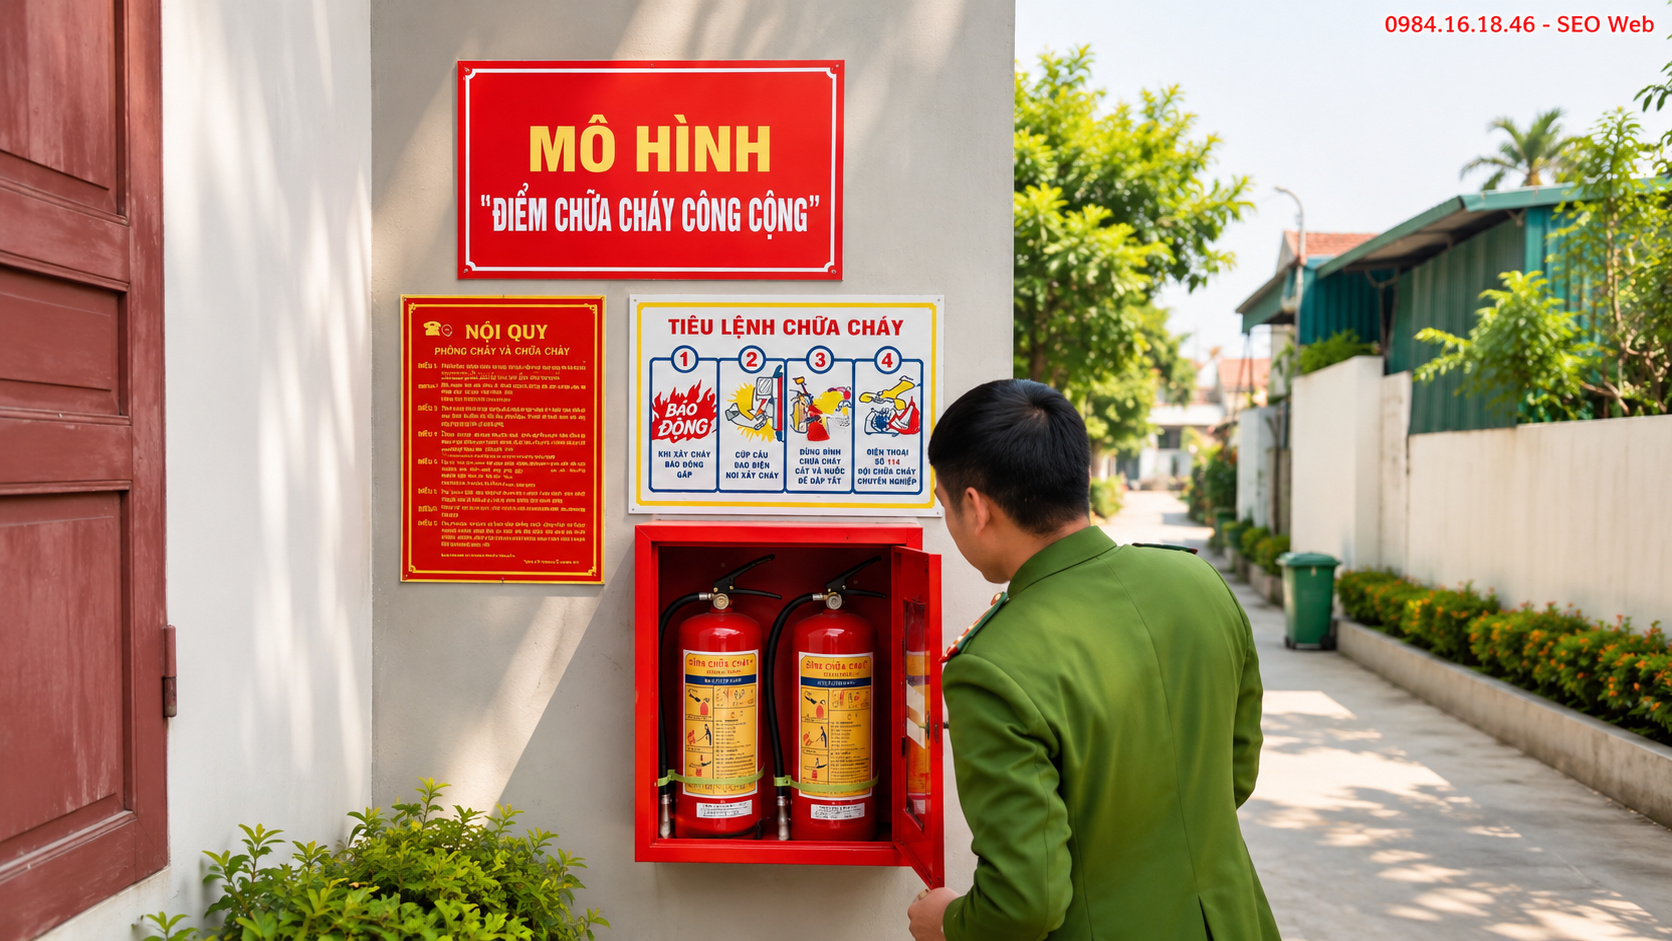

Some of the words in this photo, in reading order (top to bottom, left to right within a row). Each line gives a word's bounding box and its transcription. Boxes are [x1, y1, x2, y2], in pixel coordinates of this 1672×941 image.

[529, 113, 616, 173] MÔ
[636, 113, 771, 173] HÌNH
[554, 188, 612, 232] CHỮA
[618, 190, 676, 233] CHÁY
[681, 189, 741, 233] CÔNG
[465, 320, 501, 344] NỘI
[507, 323, 548, 343] QUY
[667, 314, 714, 336] TIÊU
[721, 314, 775, 340] LỆNH
[782, 315, 841, 336] CHỮA
[847, 315, 904, 336] CHÁY
[679, 351, 688, 367] 1
[746, 351, 758, 368] 2
[814, 352, 826, 368] 3
[881, 352, 893, 368] 4
[665, 399, 698, 418] BÁO
[657, 417, 709, 440] ĐỘNG
[657, 450, 672, 458] KHI
